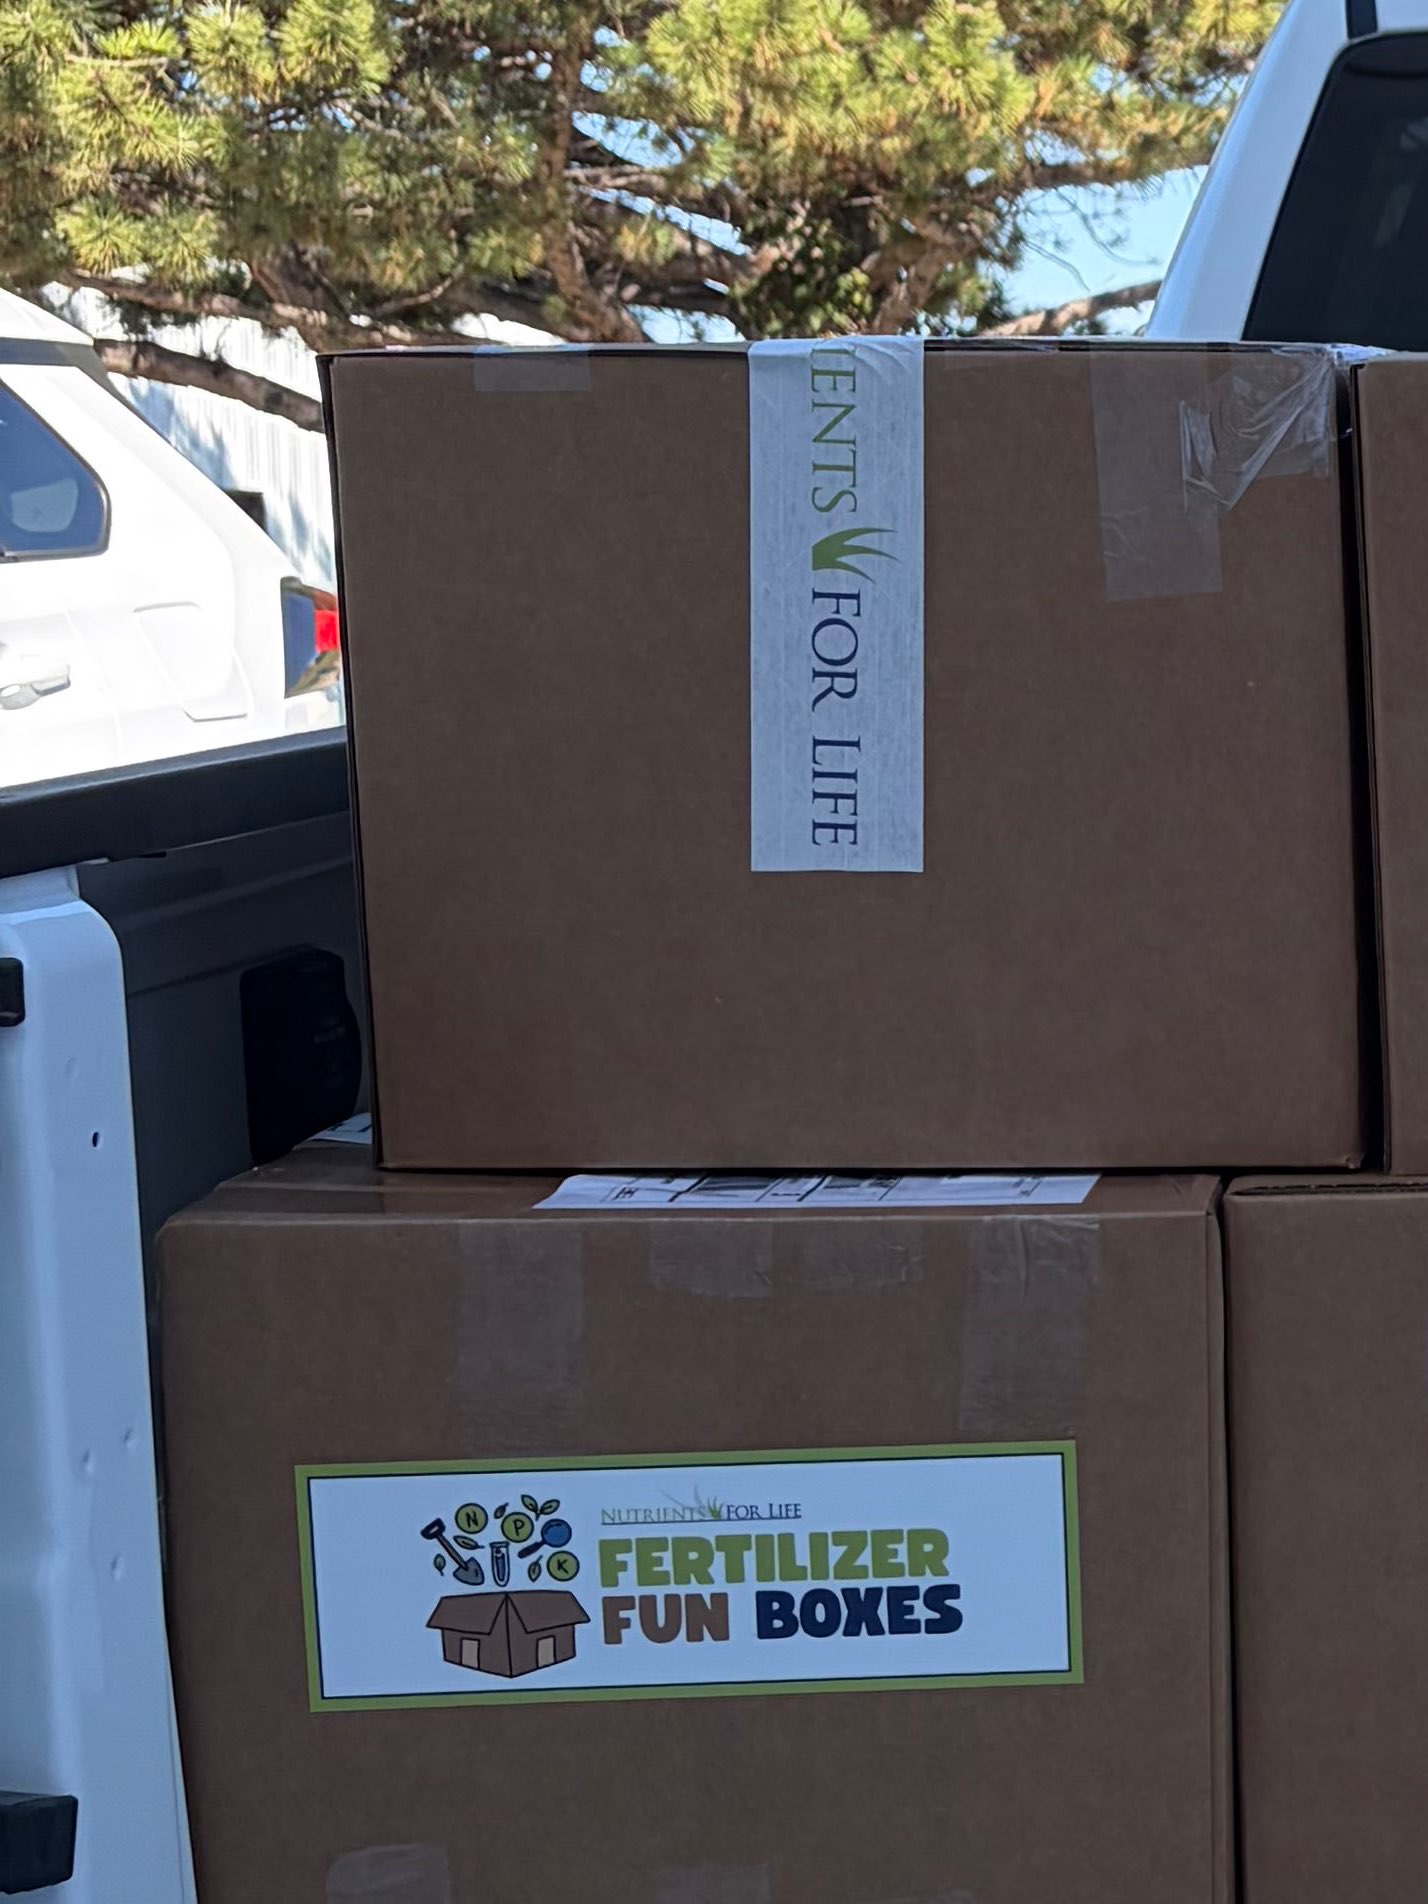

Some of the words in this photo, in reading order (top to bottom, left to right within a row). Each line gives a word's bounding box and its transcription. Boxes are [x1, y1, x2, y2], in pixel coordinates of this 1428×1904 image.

[810, 587, 862, 712] FOR
[810, 734, 862, 847] LIFE
[466, 1510, 479, 1527] N
[514, 1520, 525, 1536] P
[601, 1506, 707, 1525] NUTRIENTS
[726, 1503, 762, 1521] FOR
[769, 1502, 802, 1520] LIFE
[556, 1558, 568, 1574] K
[598, 1528, 949, 1588] FERTILIZER
[602, 1592, 730, 1645] FUN
[755, 1584, 963, 1639] BOXES
